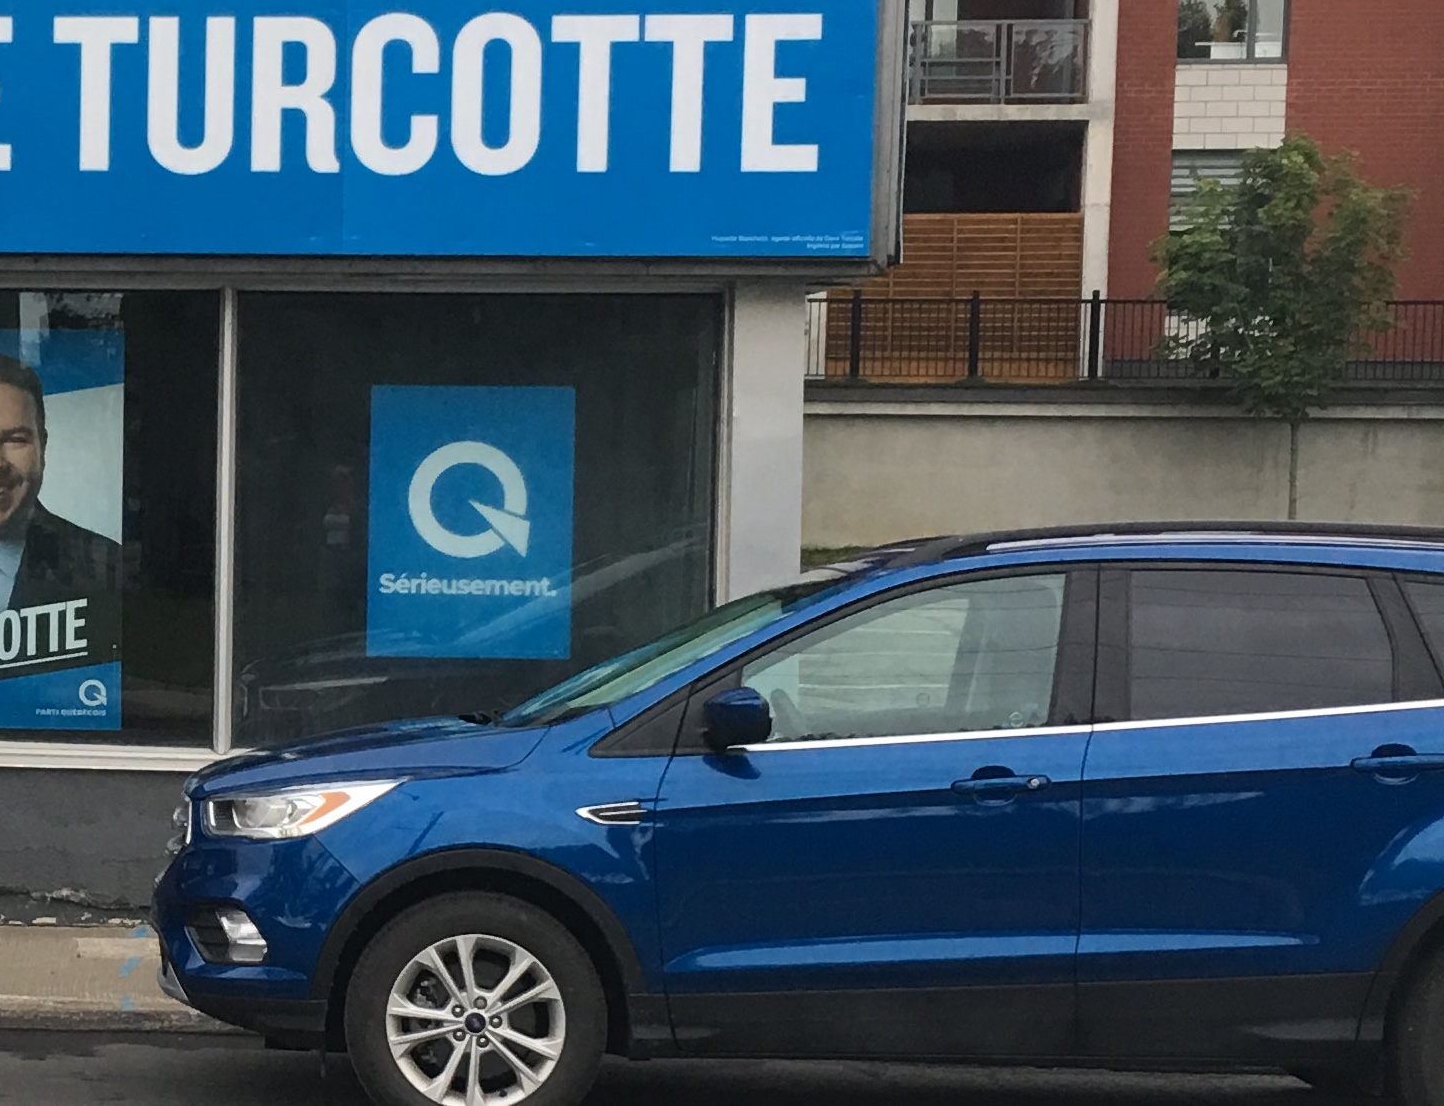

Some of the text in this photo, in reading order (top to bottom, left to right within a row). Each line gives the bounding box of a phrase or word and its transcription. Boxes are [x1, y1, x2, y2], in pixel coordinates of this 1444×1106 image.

[53, 12, 823, 176] TURCOTTE
[379, 572, 557, 596] Sérieusement.
[35, 708, 59, 716] PARTI
